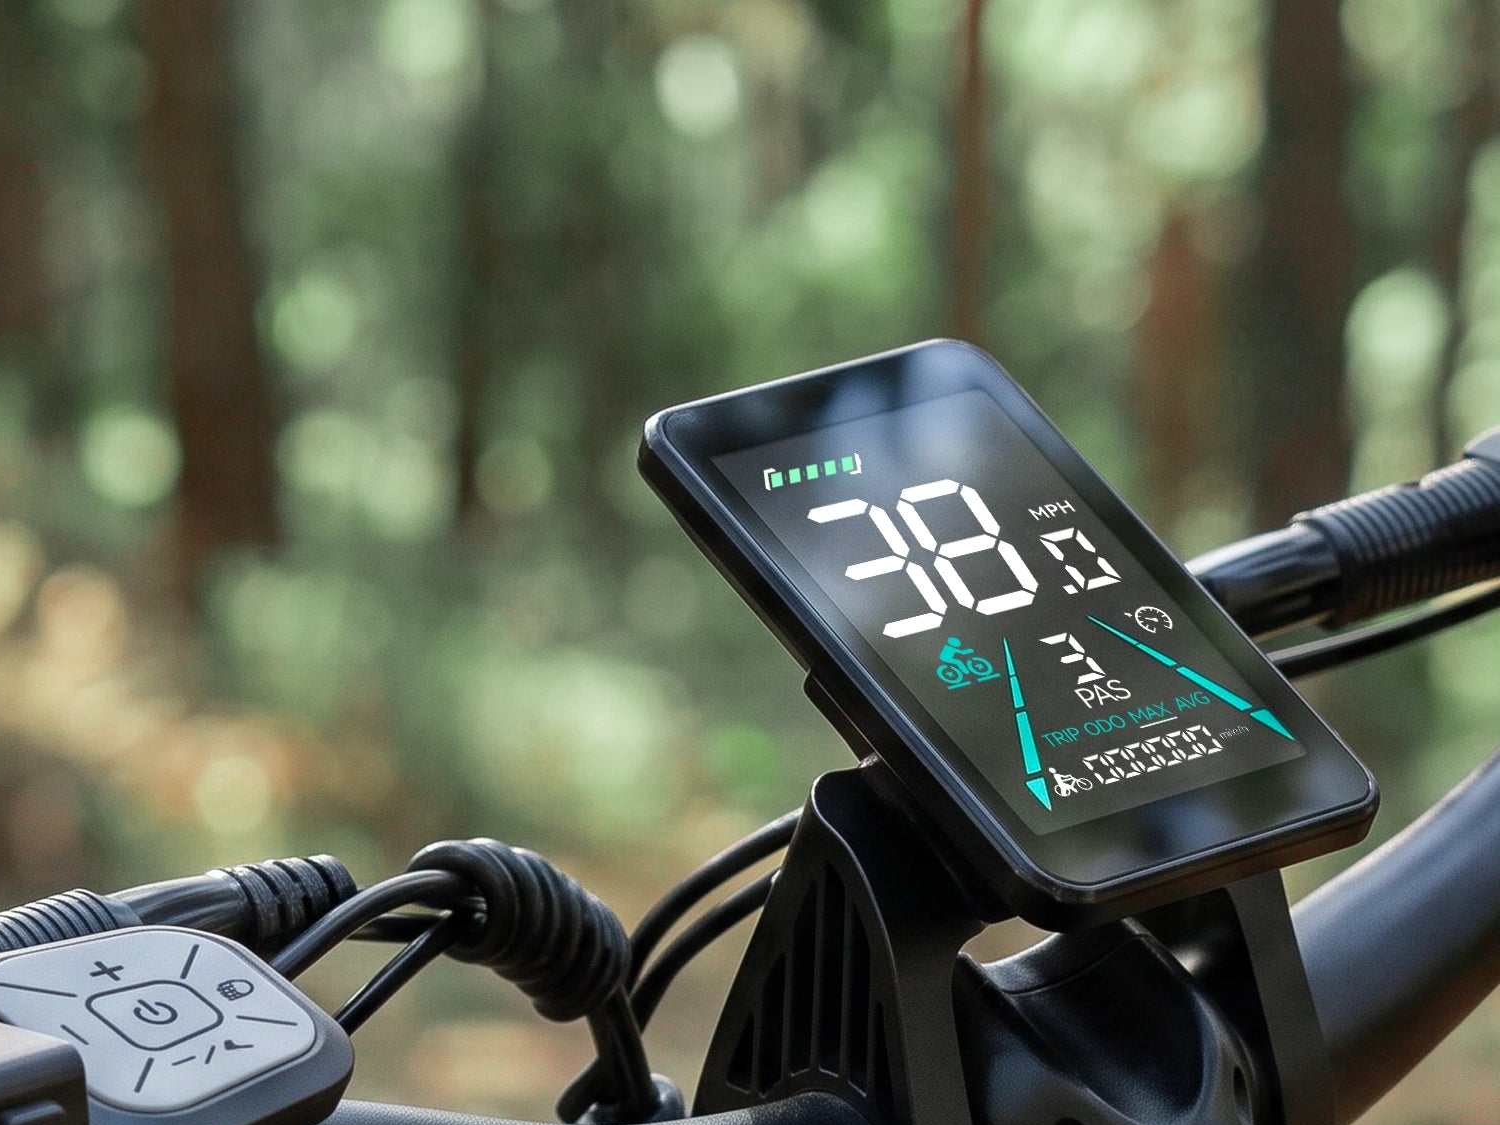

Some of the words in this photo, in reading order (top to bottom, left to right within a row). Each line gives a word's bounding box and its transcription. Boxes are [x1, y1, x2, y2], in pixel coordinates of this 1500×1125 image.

[1028, 500, 1076, 520] MPH
[1039, 632, 1106, 684] 3
[1074, 679, 1132, 709] PAS
[1041, 727, 1080, 748] TRIP
[1083, 715, 1127, 737] ODO
[1128, 702, 1173, 724] MAX
[1176, 691, 1211, 713] AVG
